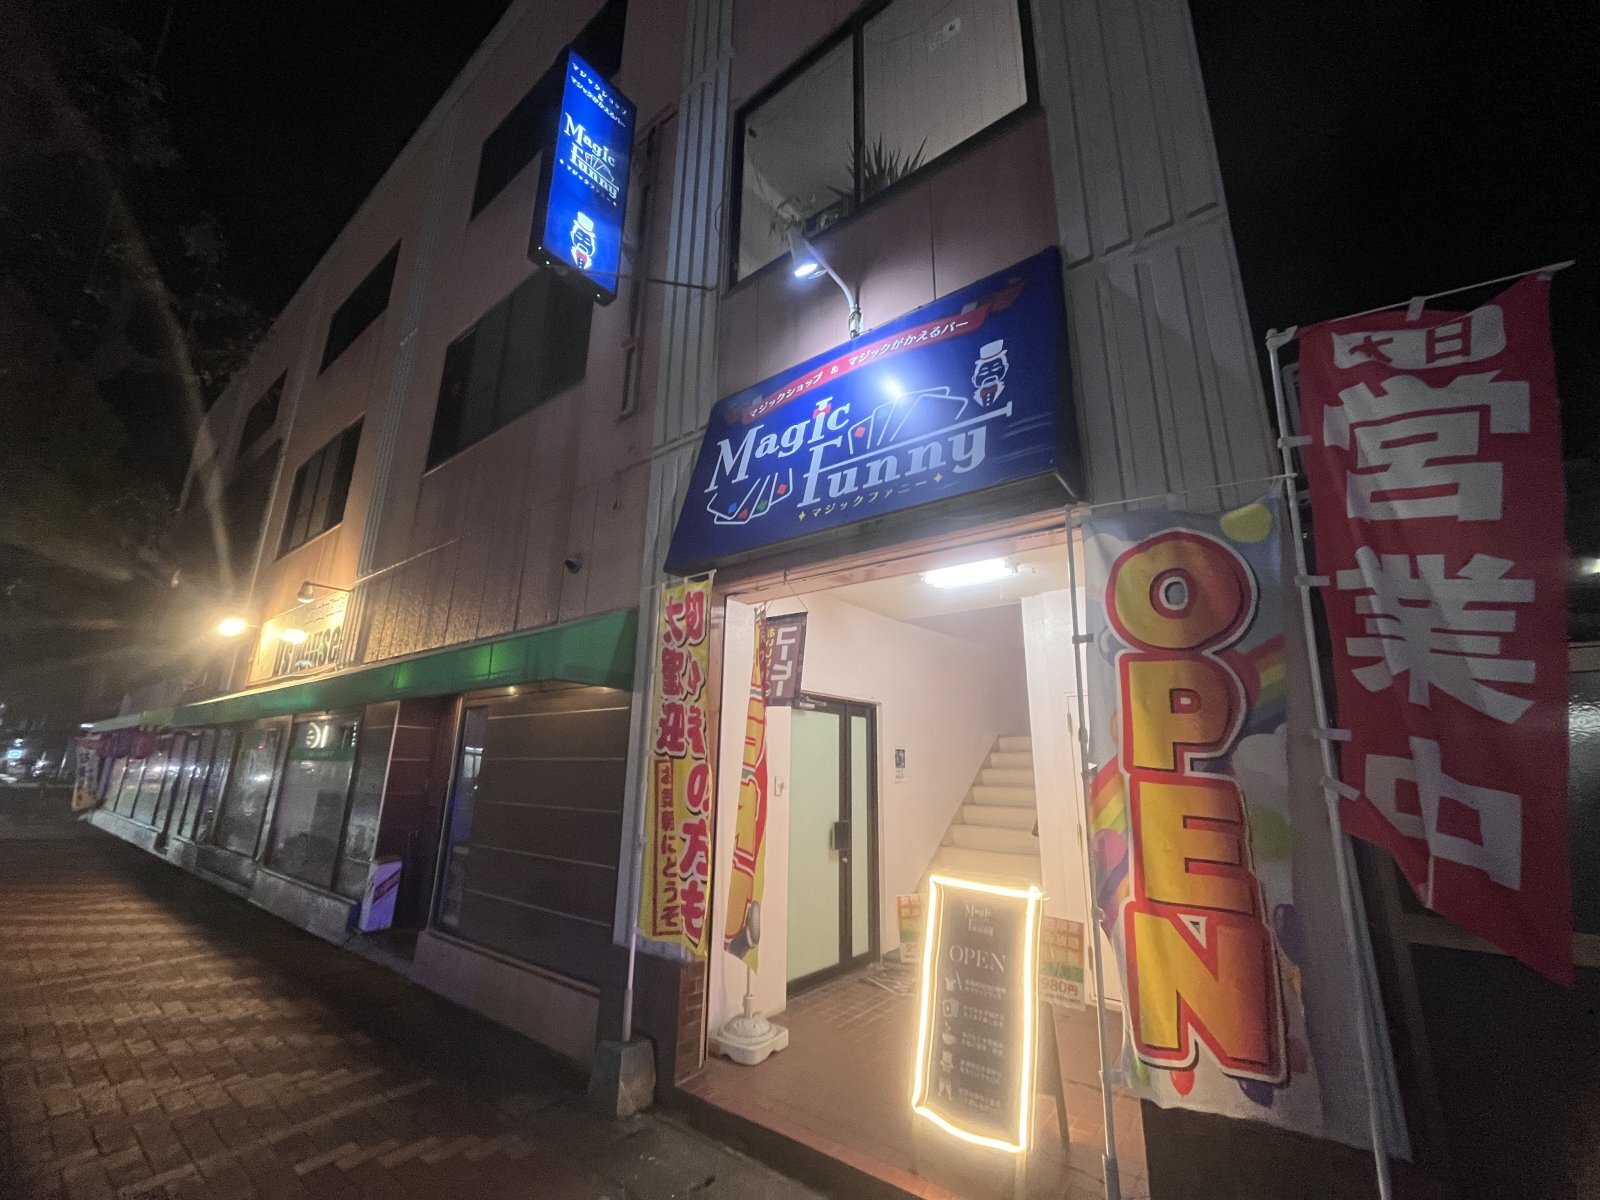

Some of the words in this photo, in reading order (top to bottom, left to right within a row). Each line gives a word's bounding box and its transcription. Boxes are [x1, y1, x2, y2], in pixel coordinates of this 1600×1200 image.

[564, 112, 616, 168] Magic
[570, 142, 620, 200] Funny
[748, 371, 824, 418] マジックショップ
[829, 364, 840, 375] &
[847, 320, 970, 368] マジックがかえるバー
[704, 397, 851, 494] Magic
[797, 401, 1013, 508] Funny
[811, 479, 930, 518] マジックファニー
[1323, 371, 1536, 890] 営業中
[1106, 529, 1288, 1082] OPEN
[949, 944, 1007, 974] OPEN
